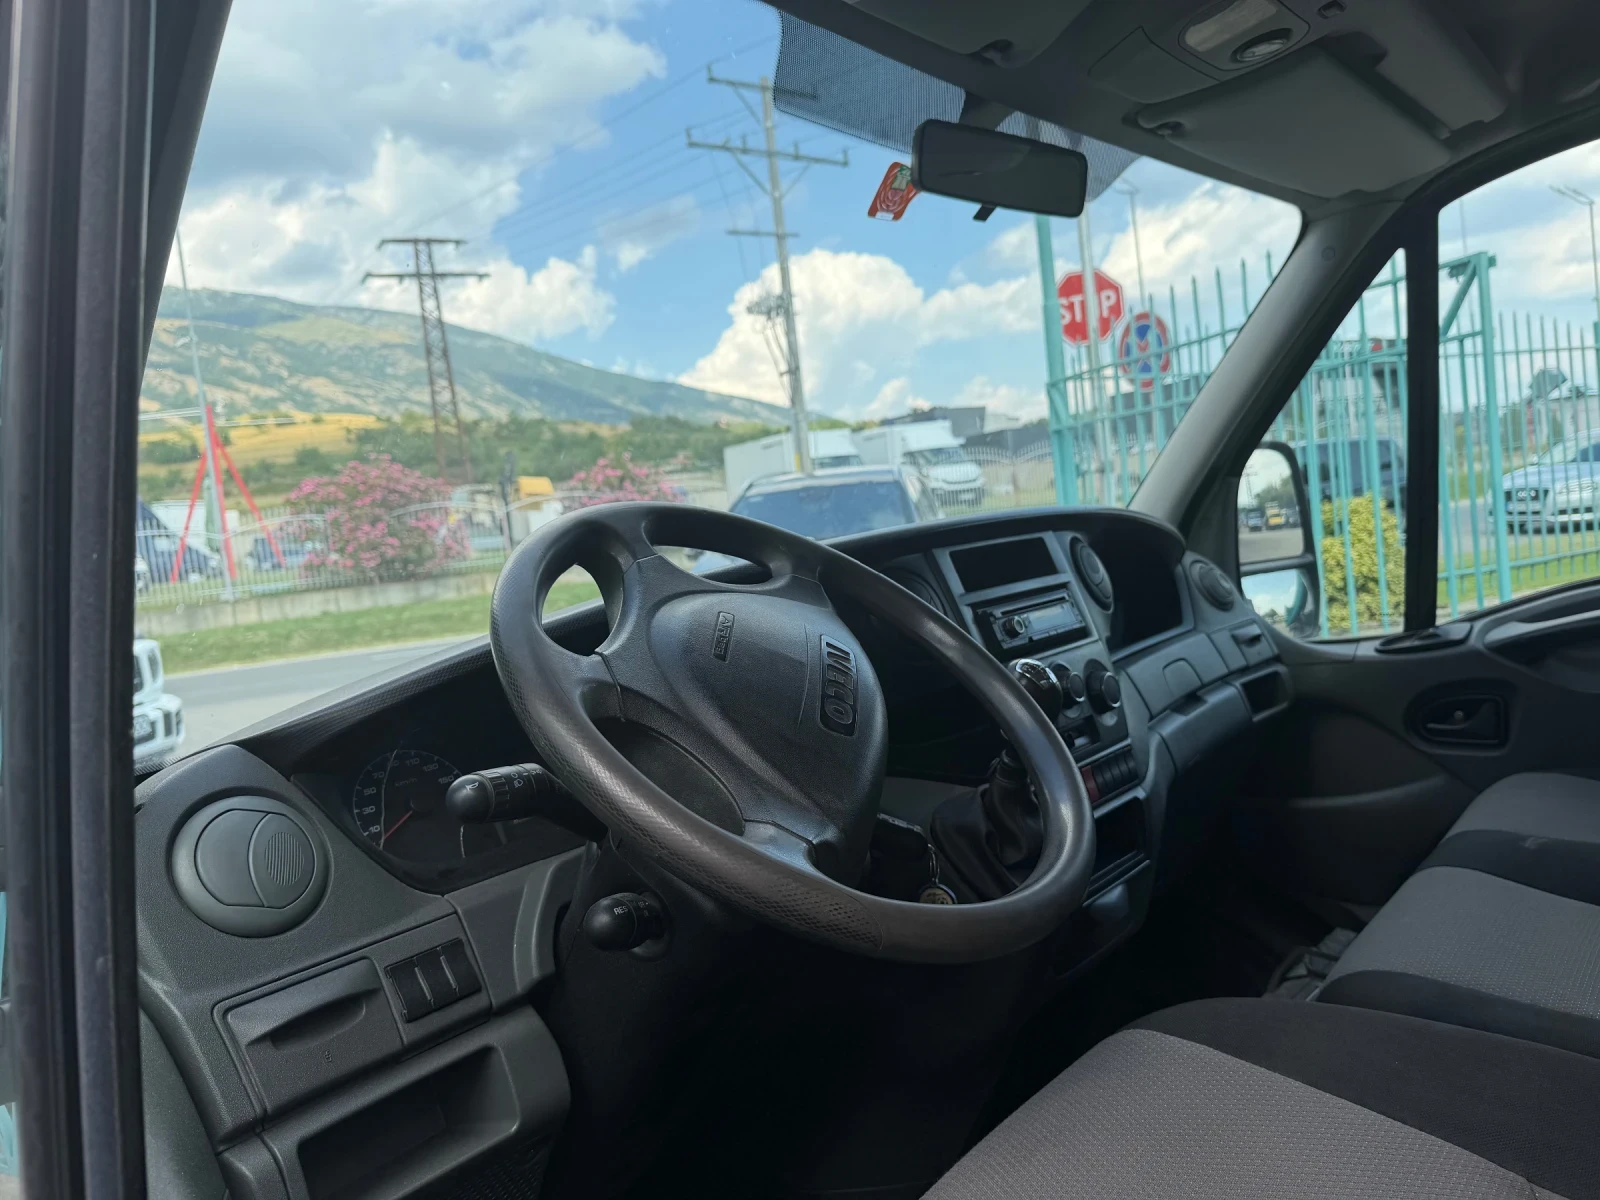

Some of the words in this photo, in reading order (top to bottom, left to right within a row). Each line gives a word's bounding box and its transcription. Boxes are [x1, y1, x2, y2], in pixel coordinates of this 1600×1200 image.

[1058, 289, 1117, 325] STP
[824, 641, 854, 725] IVECO
[423, 763, 439, 772] 130
[372, 771, 385, 779] 70
[438, 775, 454, 784] 150
[363, 787, 377, 796] 50
[362, 806, 376, 815] 30
[368, 825, 381, 834] 10
[613, 905, 629, 915] RES
